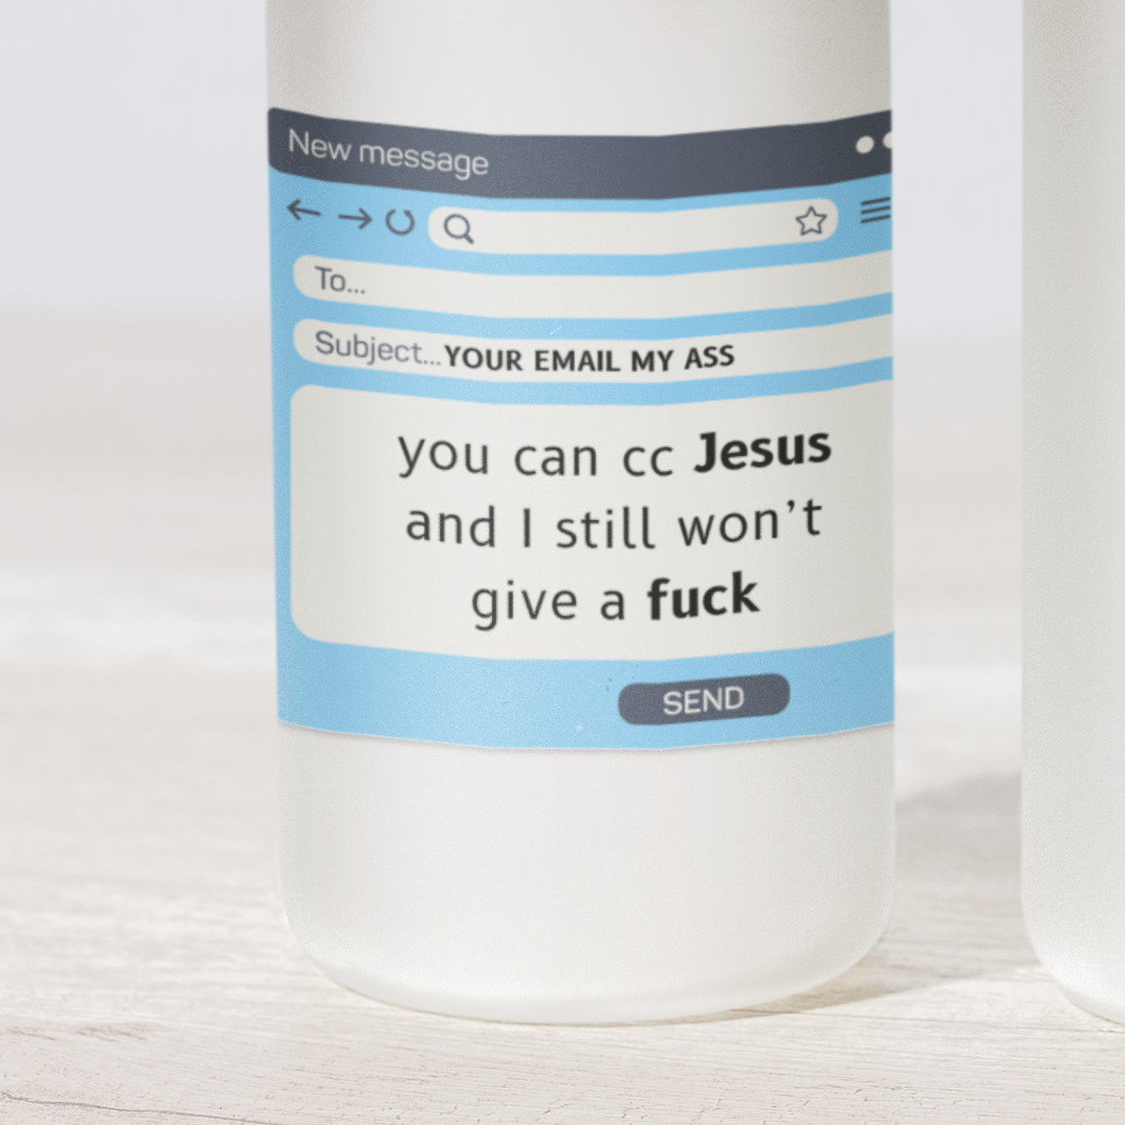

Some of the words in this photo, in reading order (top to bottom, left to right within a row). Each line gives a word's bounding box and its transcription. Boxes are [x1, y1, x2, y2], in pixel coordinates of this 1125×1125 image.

[288, 128, 351, 162] New
[359, 143, 489, 180] message
[314, 266, 366, 294] To...
[444, 345, 523, 371] YOUR
[535, 350, 620, 372] EMAIL
[631, 350, 674, 372] MY
[684, 345, 735, 370] ASS
[398, 435, 489, 478] you
[514, 445, 597, 476] can
[622, 445, 674, 476] cc
[694, 430, 832, 473] Jesus
[406, 505, 495, 547] and
[523, 508, 531, 547] I
[556, 507, 655, 549] still
[472, 580, 578, 631] give
[601, 590, 625, 620] a
[647, 571, 760, 620] fuck
[663, 687, 745, 715] SEND
